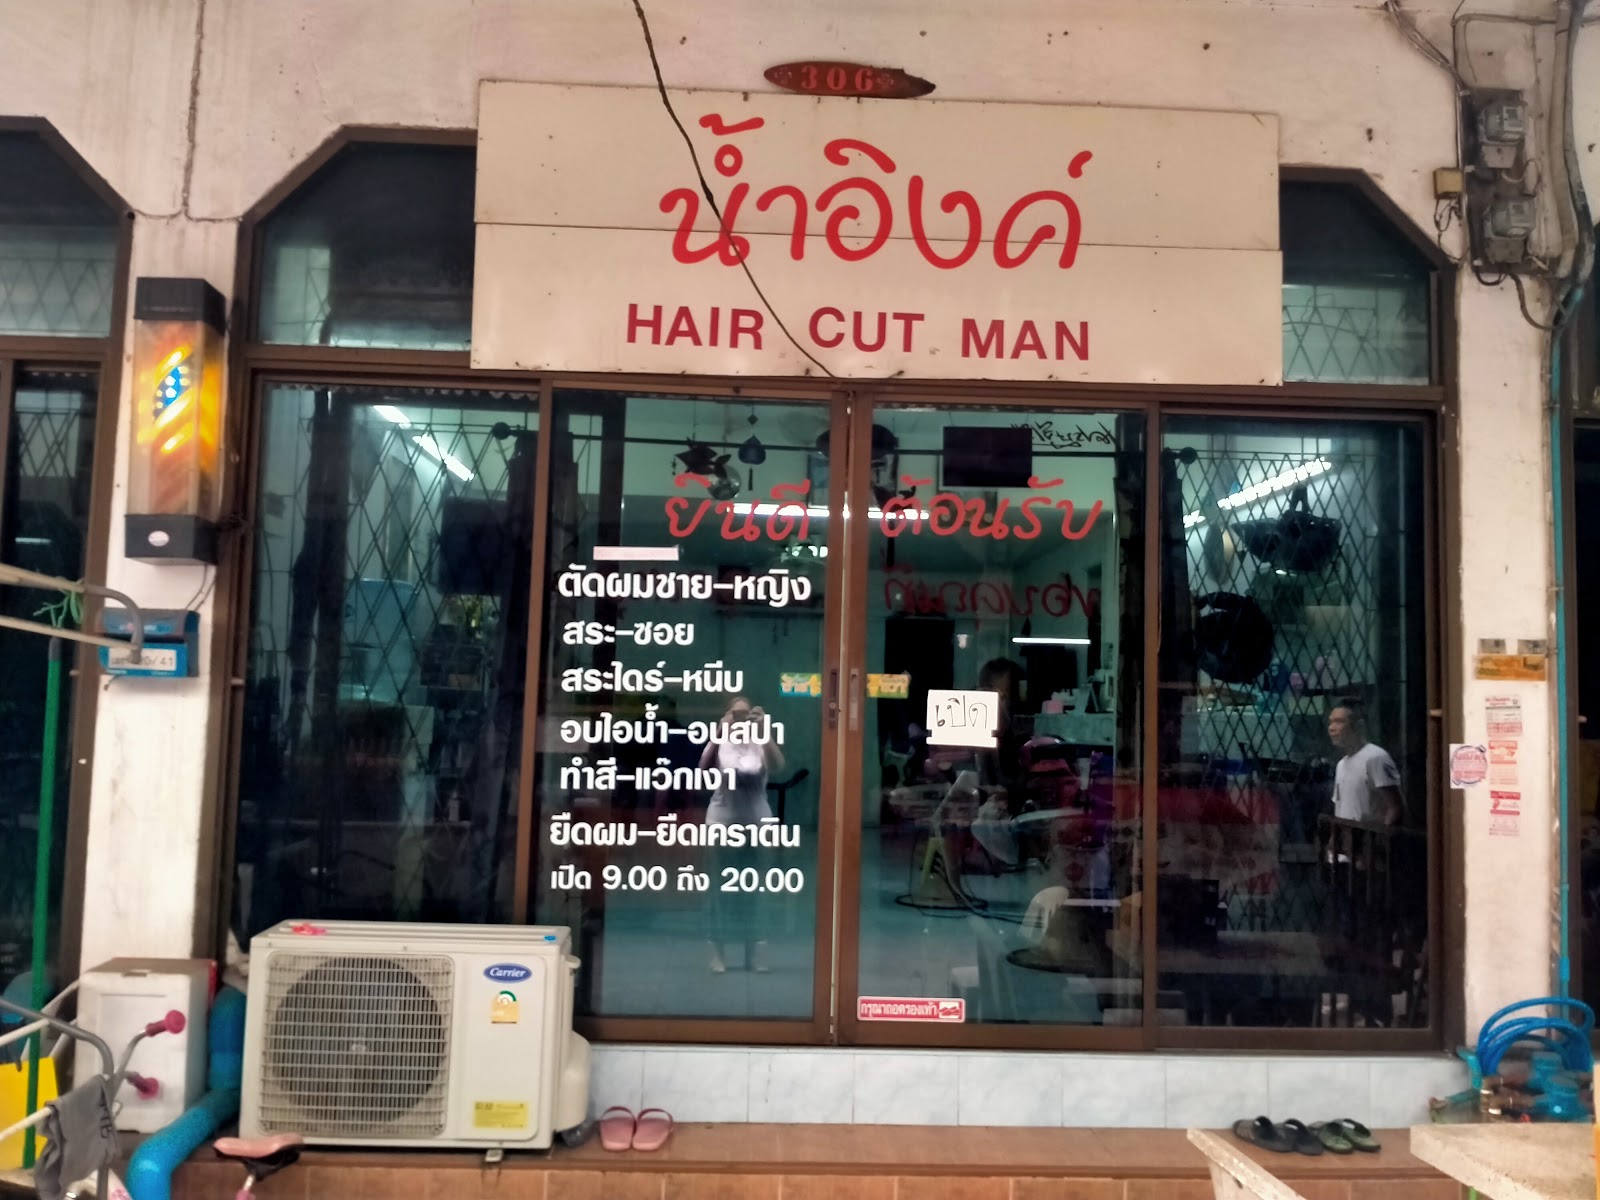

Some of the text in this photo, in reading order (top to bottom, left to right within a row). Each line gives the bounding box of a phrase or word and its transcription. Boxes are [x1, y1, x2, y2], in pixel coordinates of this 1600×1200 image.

[801, 65, 874, 91] 306
[659, 113, 1092, 270] น้ำอิงค์
[627, 304, 1090, 361] HAIR CUT MAN
[881, 476, 1103, 539] ต้อนรับ
[557, 563, 811, 608] ตัดผมชาย-หญิง
[563, 620, 695, 646] สระ-ซอย
[561, 660, 744, 693] สระไดร์-หนีบ
[560, 704, 785, 745] อบไอน้ำ-อบสปา
[934, 695, 989, 729] เปิด
[550, 864, 804, 893] เปิด 9.00 ถึง 20.00
[489, 967, 526, 978] Carrier
